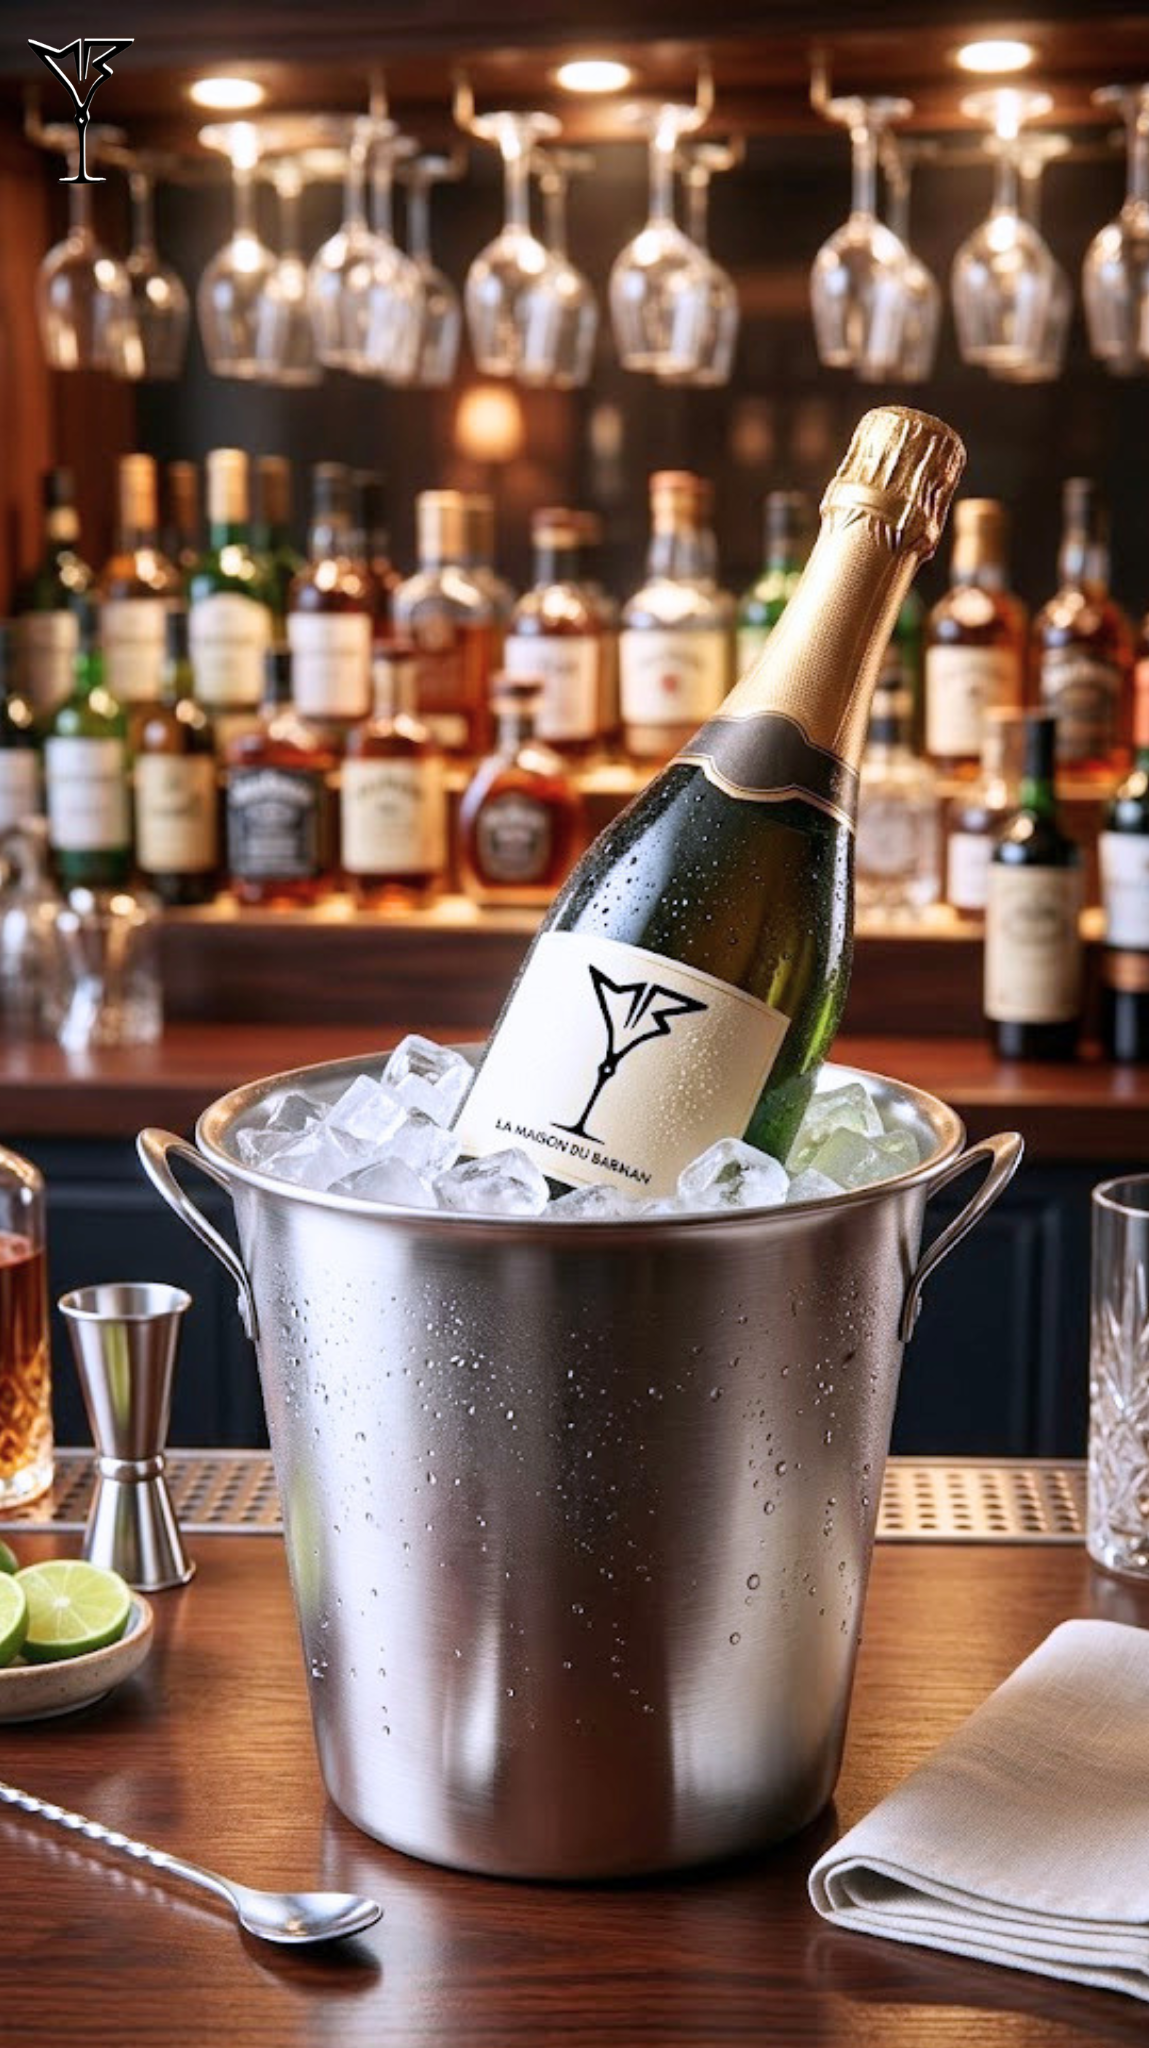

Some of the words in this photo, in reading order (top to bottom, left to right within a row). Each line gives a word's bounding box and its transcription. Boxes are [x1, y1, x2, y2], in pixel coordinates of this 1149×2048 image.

[495, 1118, 512, 1133] LA
[514, 1124, 570, 1152] MAISON
[569, 1144, 591, 1160] DU
